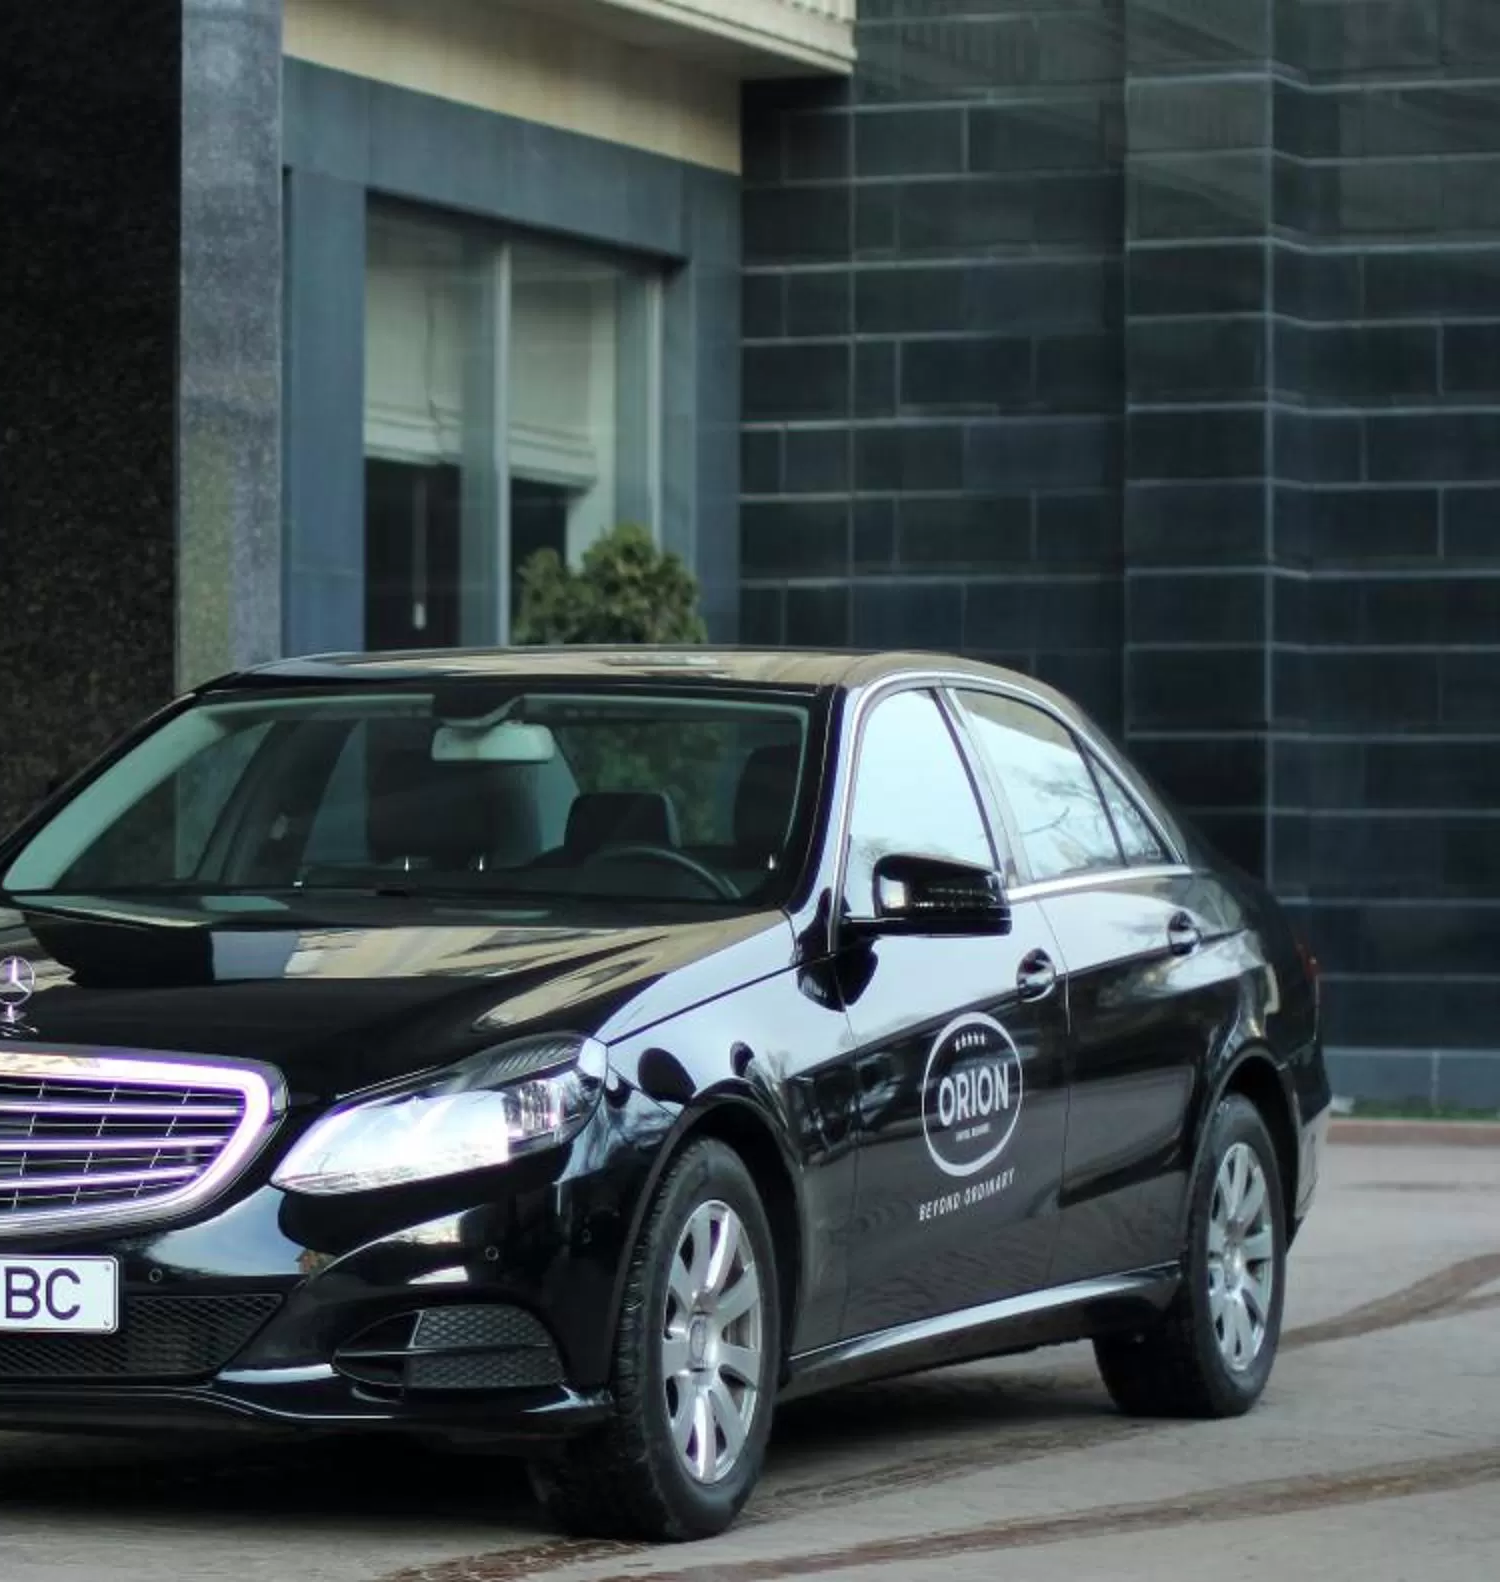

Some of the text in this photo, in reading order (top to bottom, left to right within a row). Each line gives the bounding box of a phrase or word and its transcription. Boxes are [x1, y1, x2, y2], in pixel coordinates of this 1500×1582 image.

[939, 1063, 1008, 1126] ORION
[919, 1167, 1015, 1221] BEYOND ORDINARY
[4, 1266, 81, 1320] BC
